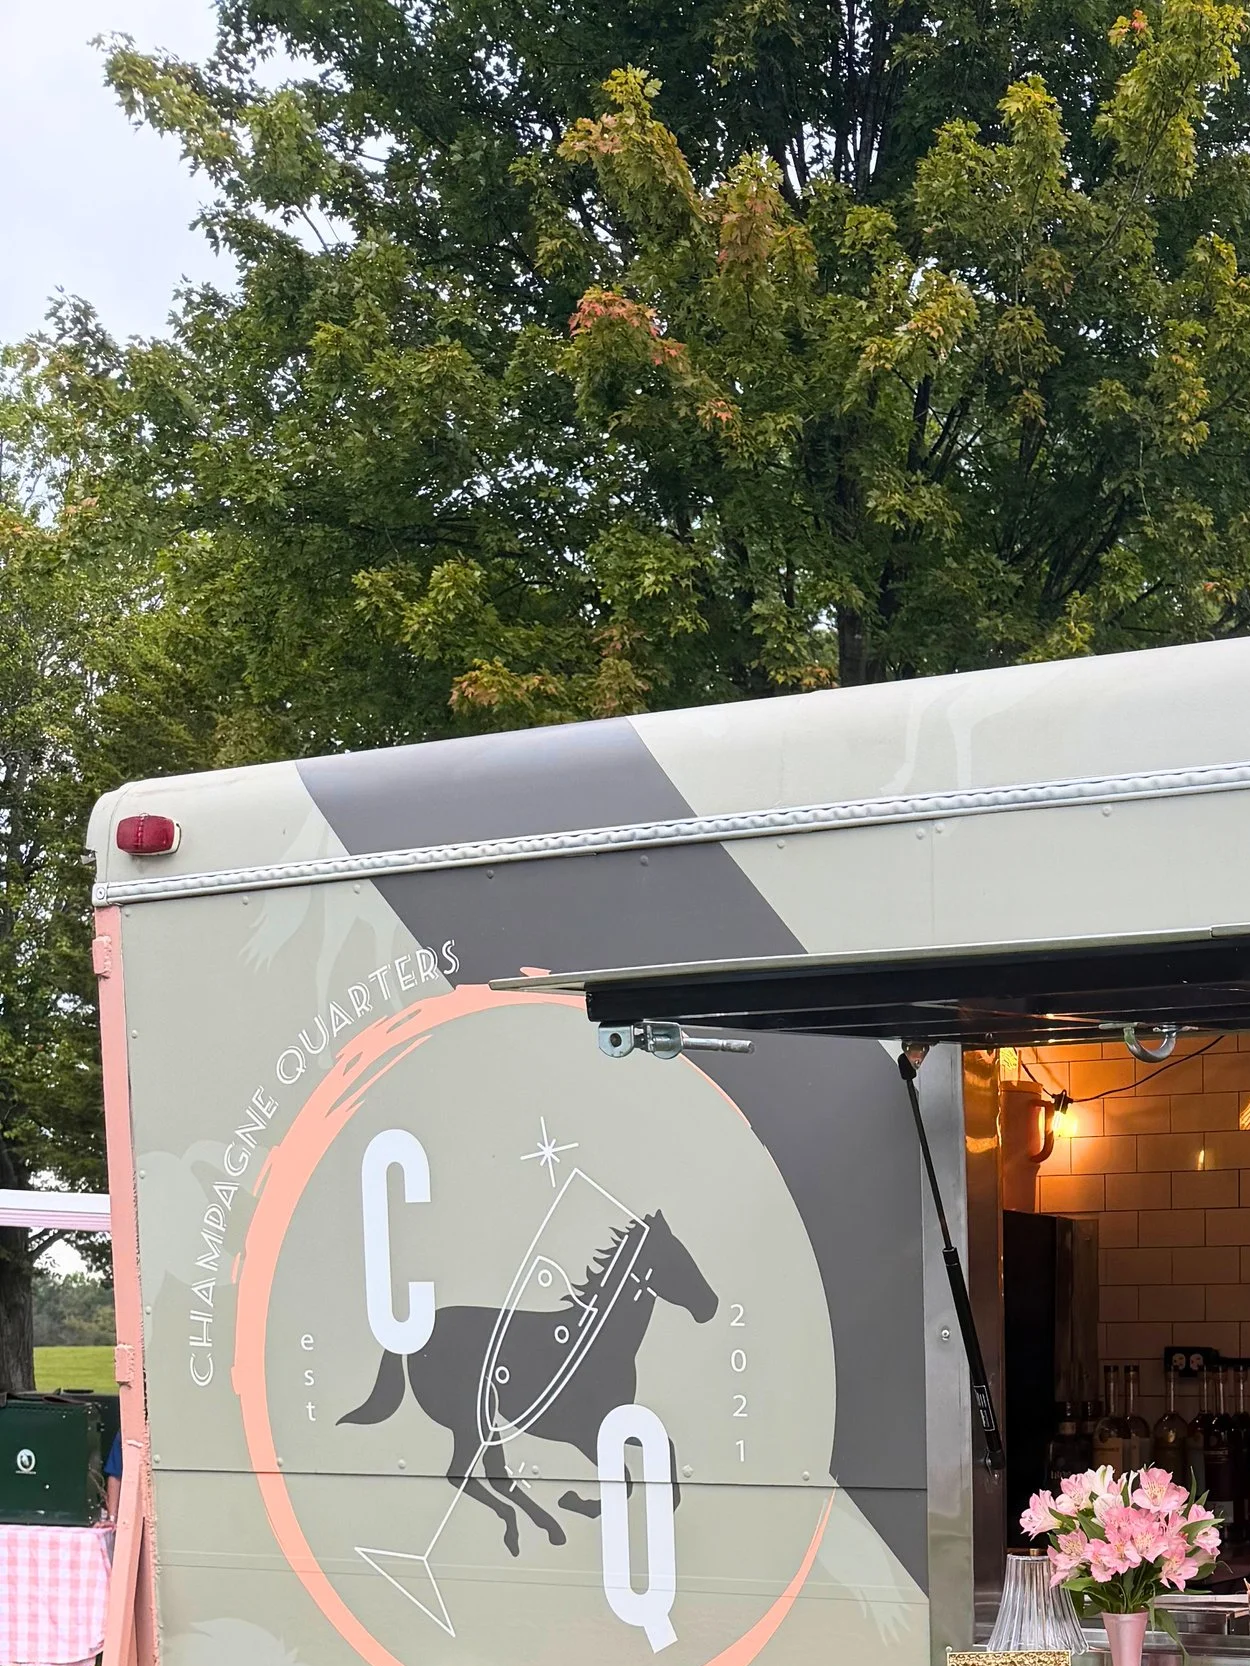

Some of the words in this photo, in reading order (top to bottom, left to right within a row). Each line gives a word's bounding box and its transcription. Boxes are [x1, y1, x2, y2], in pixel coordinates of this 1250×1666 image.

[189, 1085, 279, 1387] CHAMPAGNE
[276, 939, 461, 1085] QUARTERS
[361, 1128, 436, 1355] C
[300, 1331, 317, 1423] est
[728, 1302, 748, 1463] 2021
[597, 1403, 677, 1653] Q
